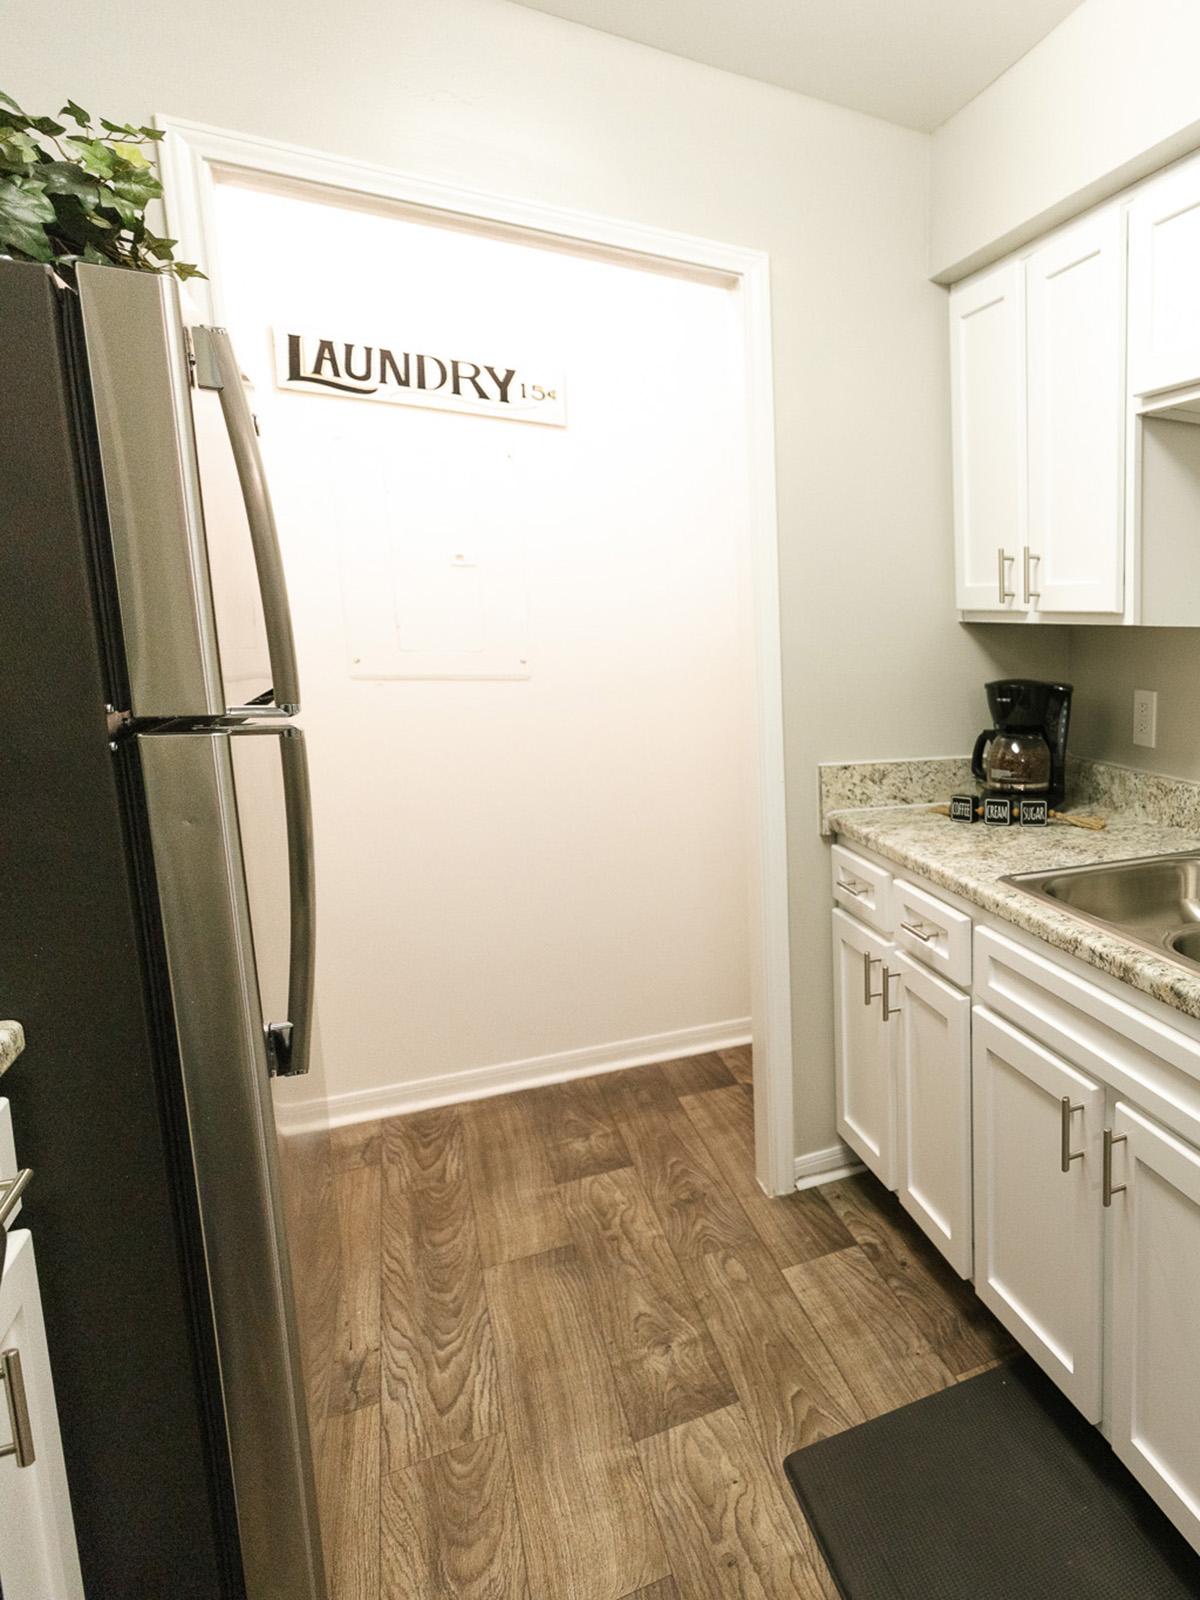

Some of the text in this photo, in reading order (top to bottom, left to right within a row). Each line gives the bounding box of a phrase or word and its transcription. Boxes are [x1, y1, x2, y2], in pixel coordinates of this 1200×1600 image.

[287, 334, 516, 404] LAUNDRY
[952, 801, 970, 817] COFFEE
[986, 804, 1008, 819] CREAM
[1022, 806, 1045, 821] SUGAR
